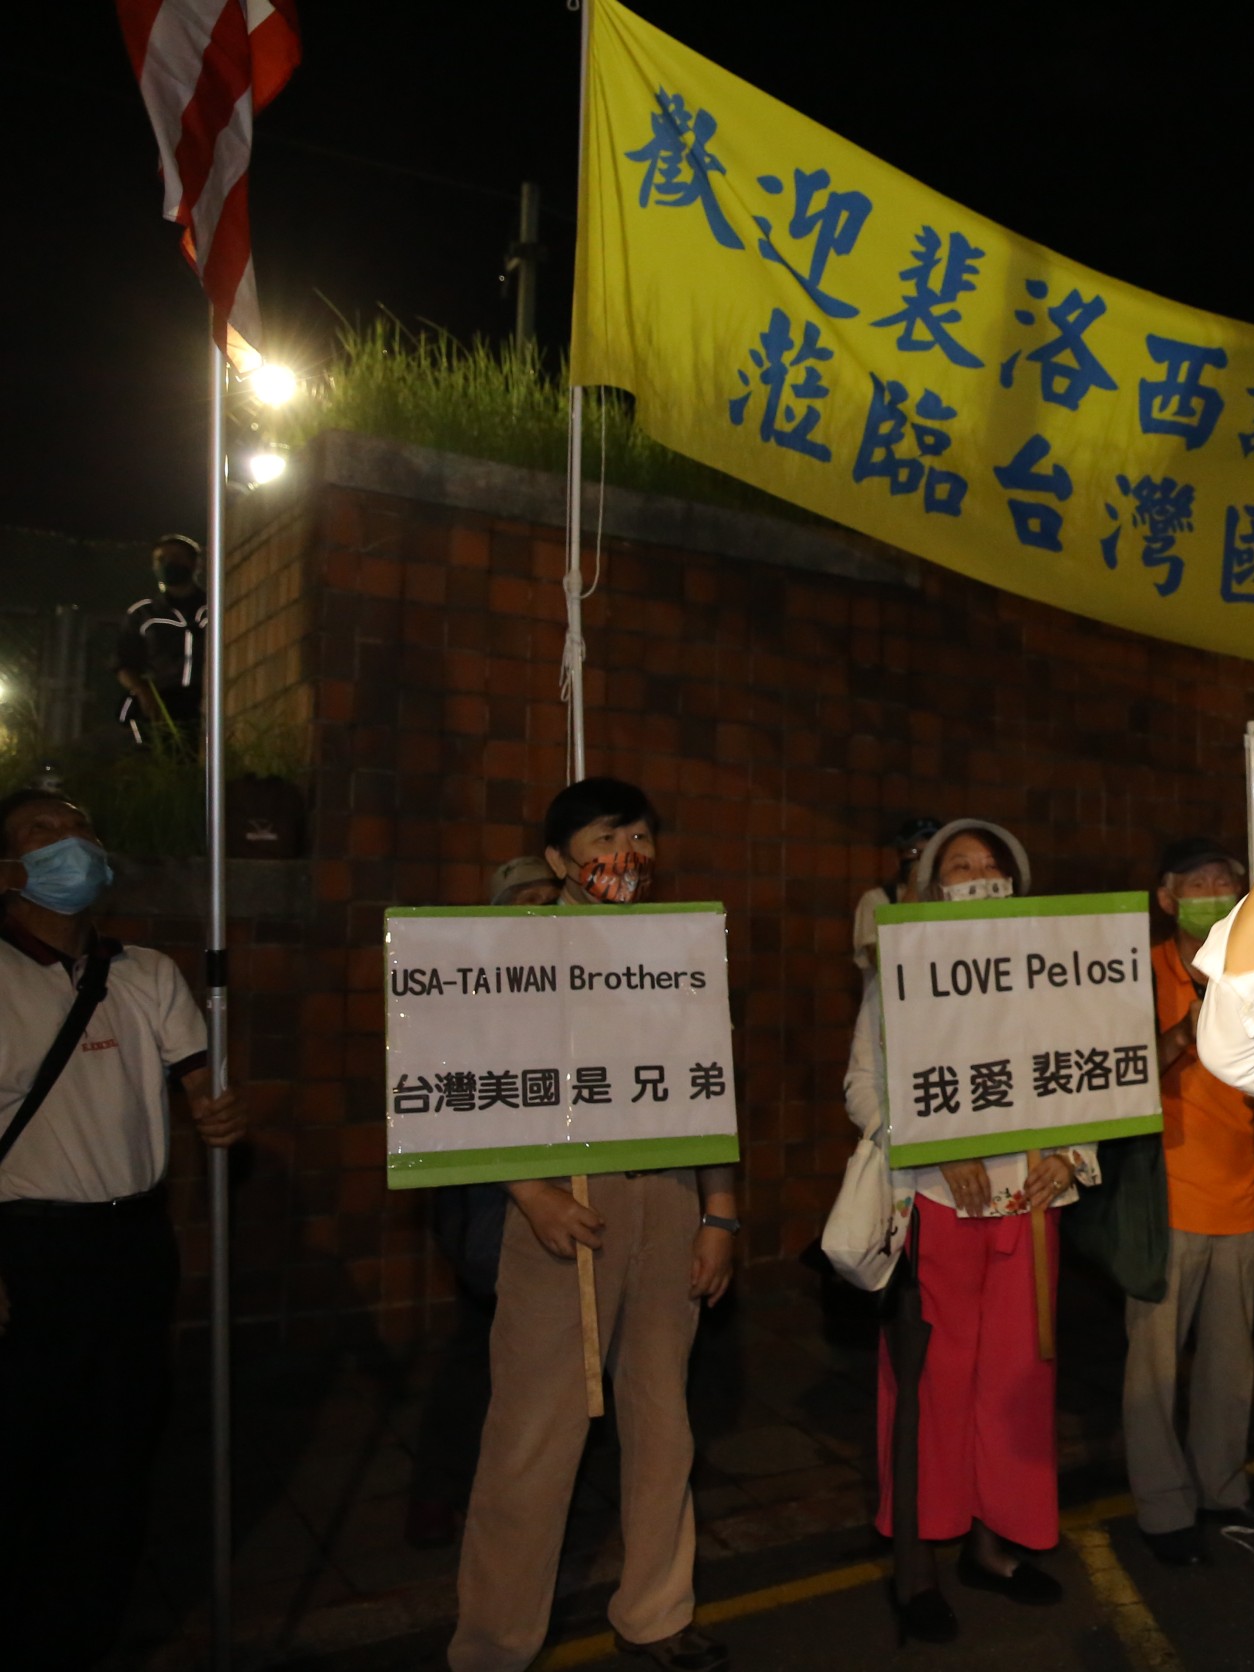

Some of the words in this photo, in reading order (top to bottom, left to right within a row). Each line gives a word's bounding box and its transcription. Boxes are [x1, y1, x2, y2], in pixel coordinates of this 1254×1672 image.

[569, 963, 707, 991] Brothers
[896, 963, 906, 1002] I
[930, 956, 1014, 998] LOVE
[1026, 946, 1139, 990] Pelosi
